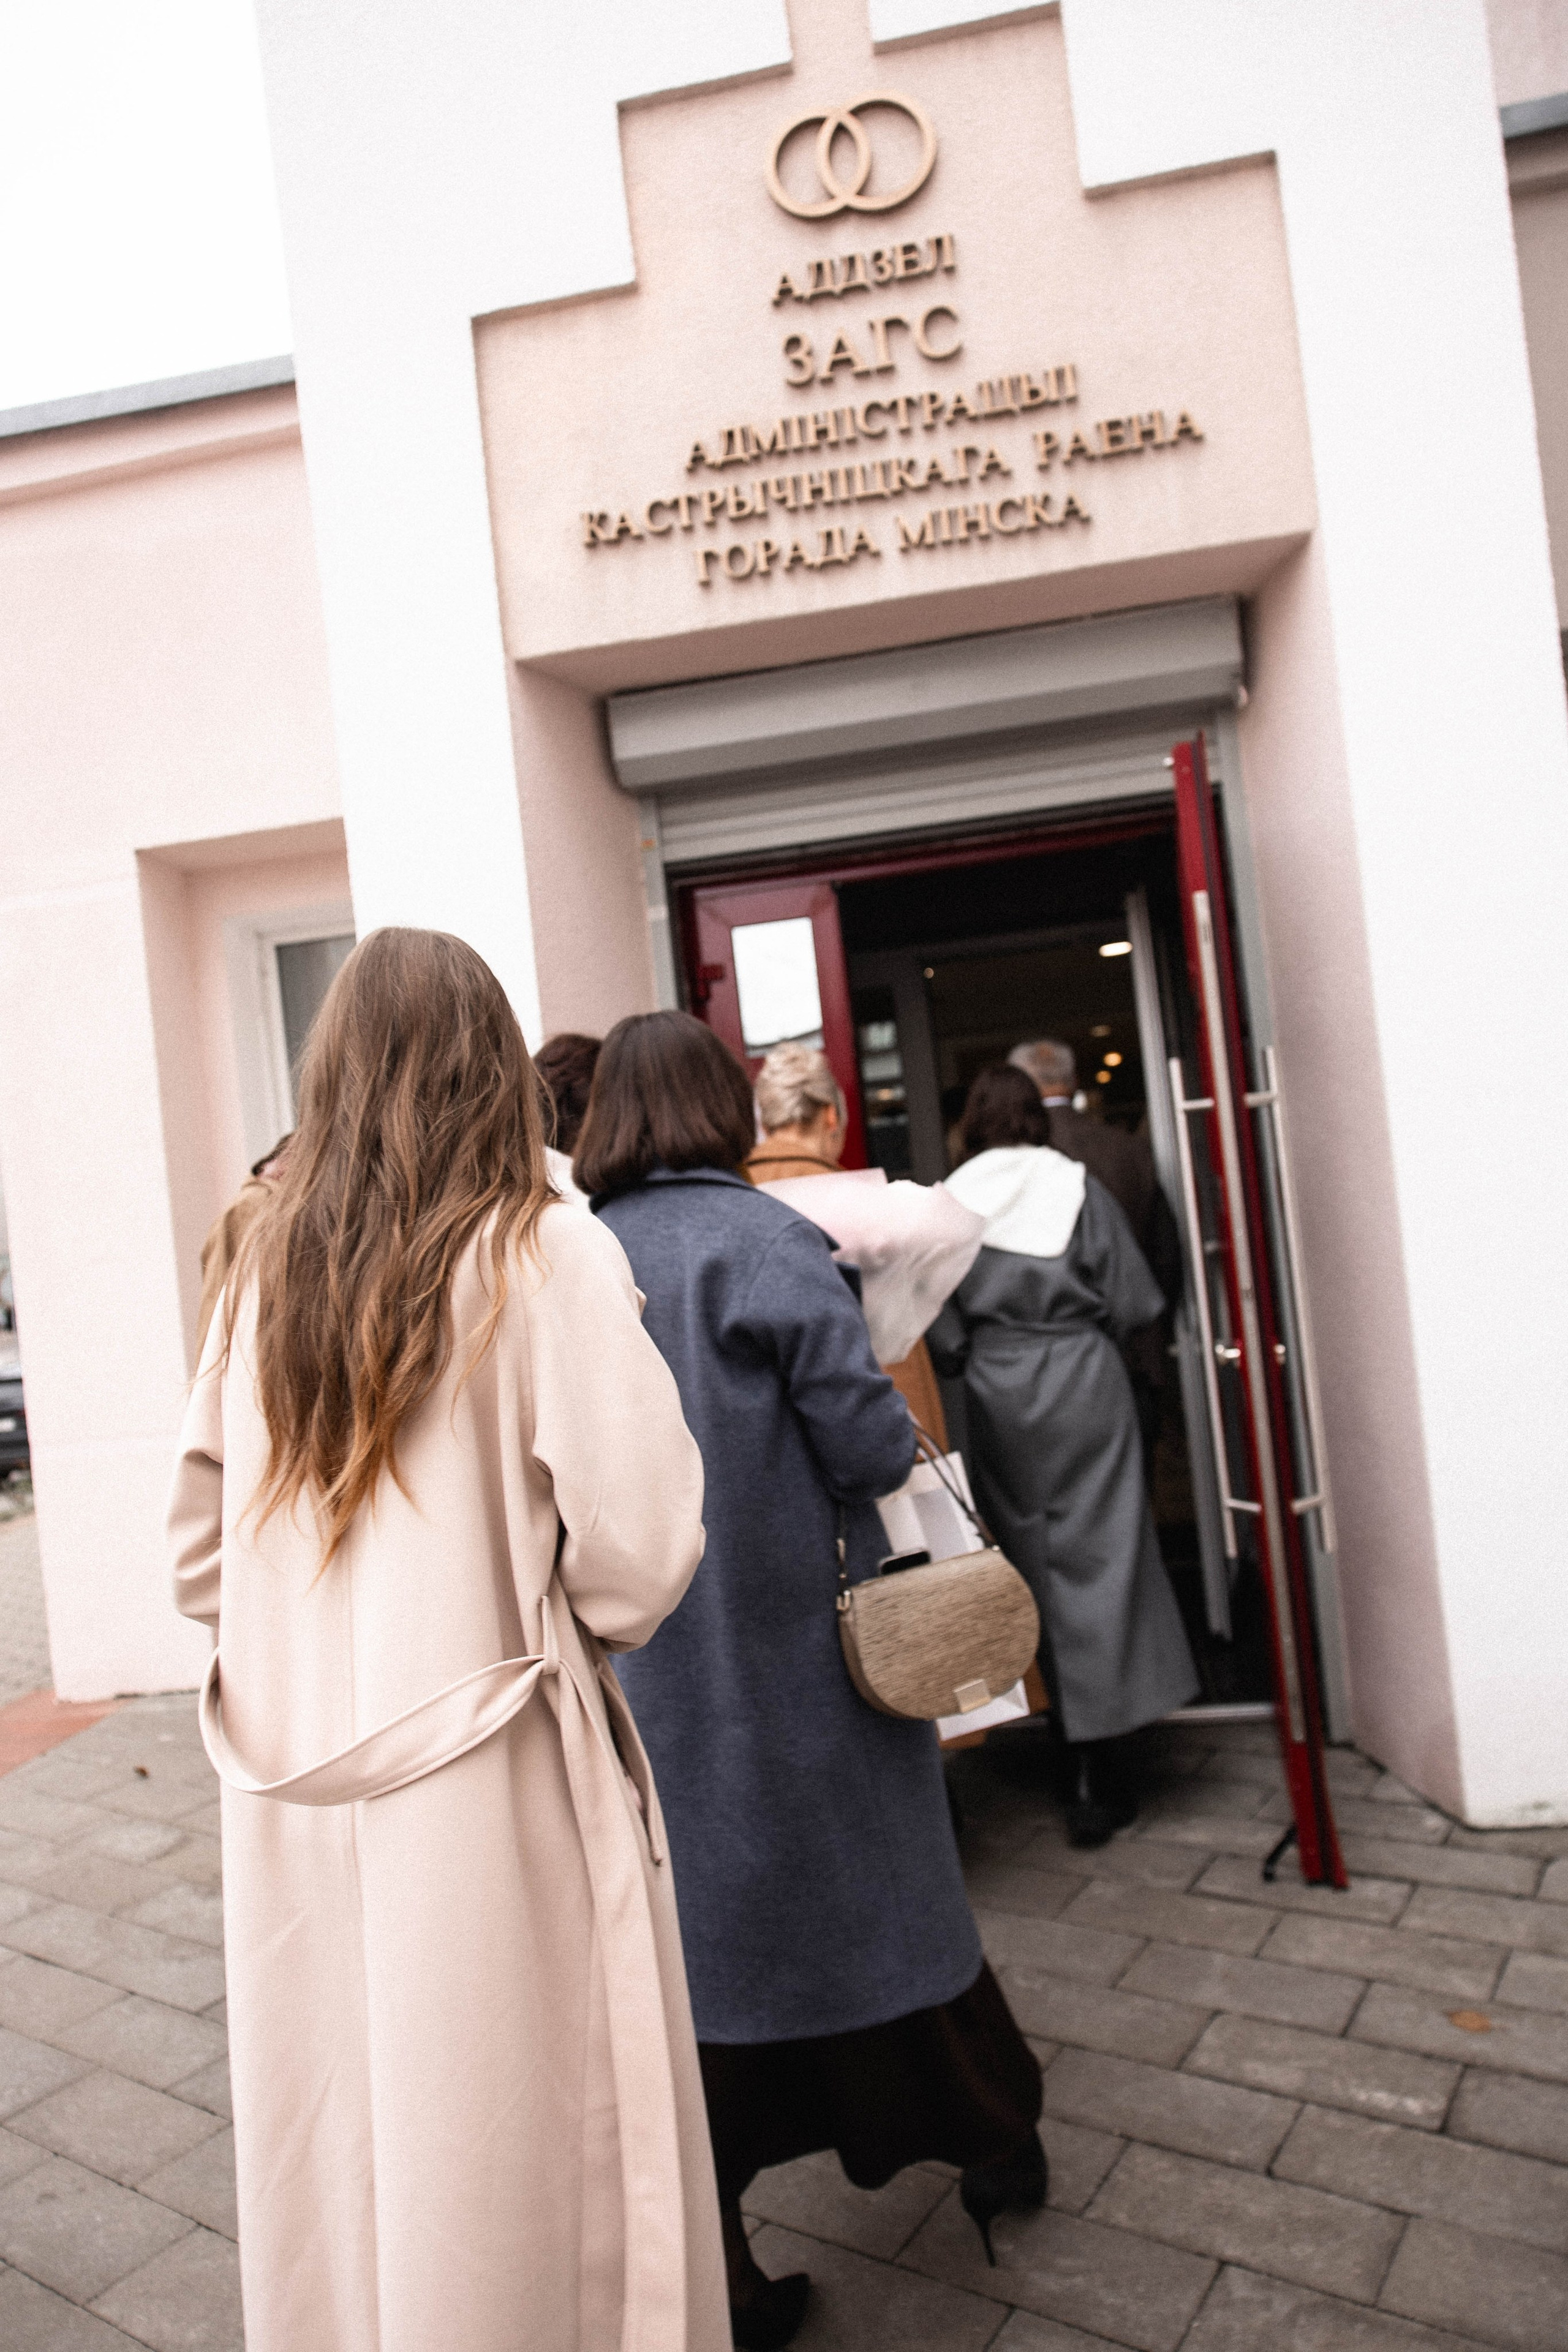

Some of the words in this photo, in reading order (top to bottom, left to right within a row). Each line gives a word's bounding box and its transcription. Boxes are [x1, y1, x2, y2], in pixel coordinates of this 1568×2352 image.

[772, 233, 956, 306] АДДЗЕЛ
[782, 303, 963, 387] ЗАГС
[685, 363, 1078, 473] АДМІНІСТРАЦЫІ
[581, 445, 1012, 548] КАСТРЫЧНІЦКАГА
[695, 527, 881, 587] ГОРАДА
[895, 490, 1091, 553] МІНСКА
